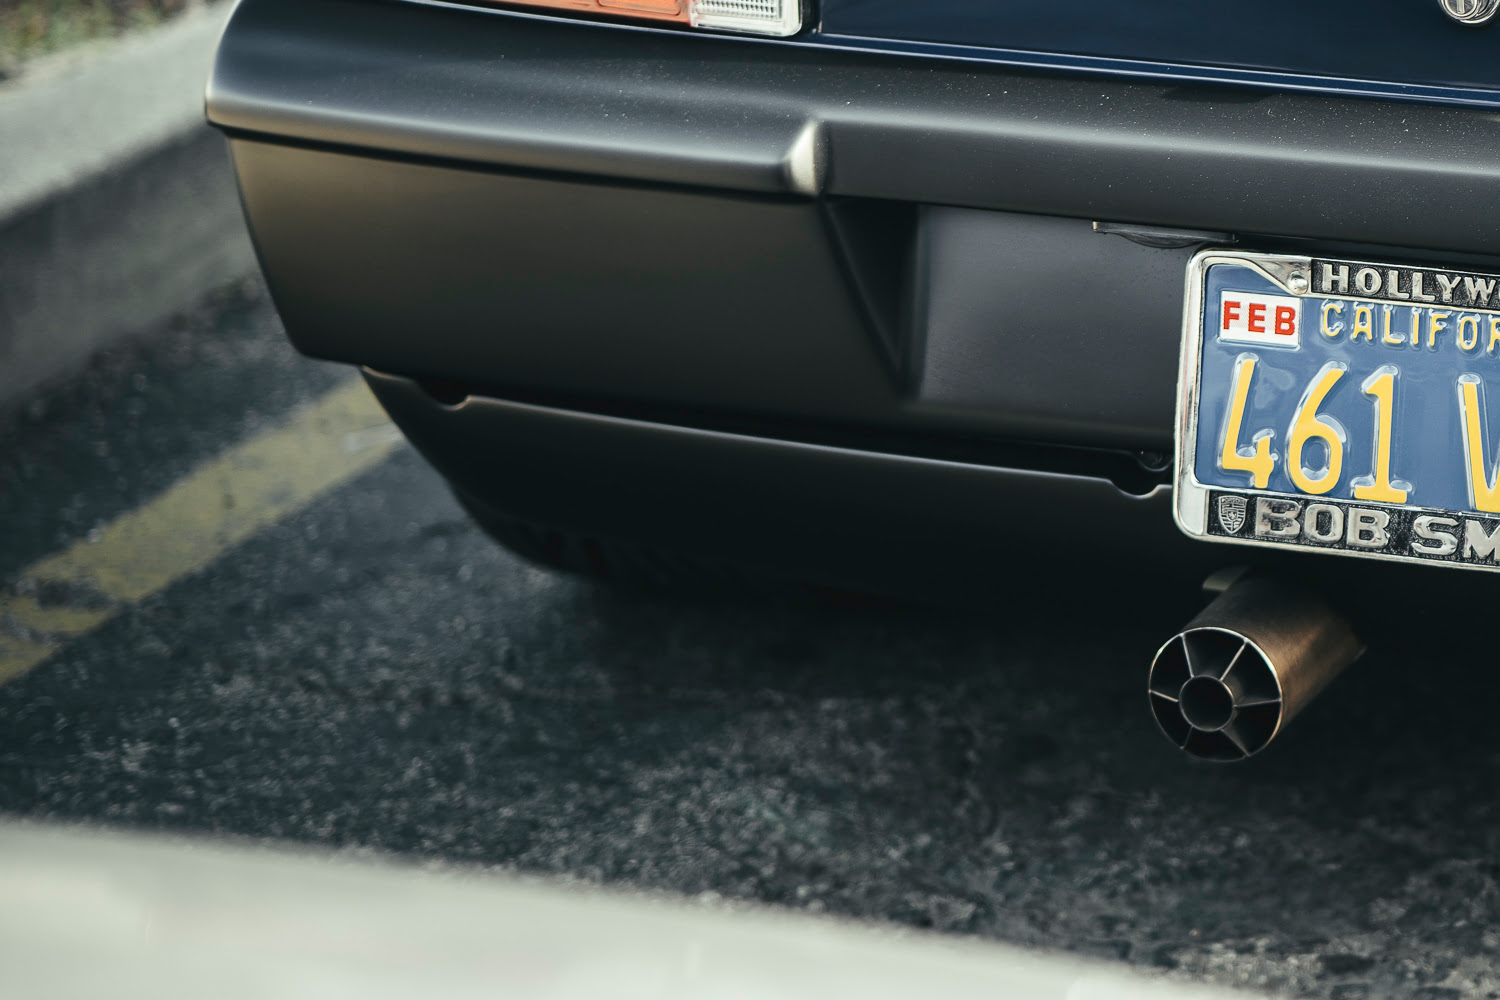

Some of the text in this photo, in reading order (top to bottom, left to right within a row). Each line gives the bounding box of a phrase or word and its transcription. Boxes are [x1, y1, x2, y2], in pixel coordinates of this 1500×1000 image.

[1222, 300, 1297, 336] FEB
[1220, 353, 1412, 505] 461
[1254, 497, 1391, 550] BOB
